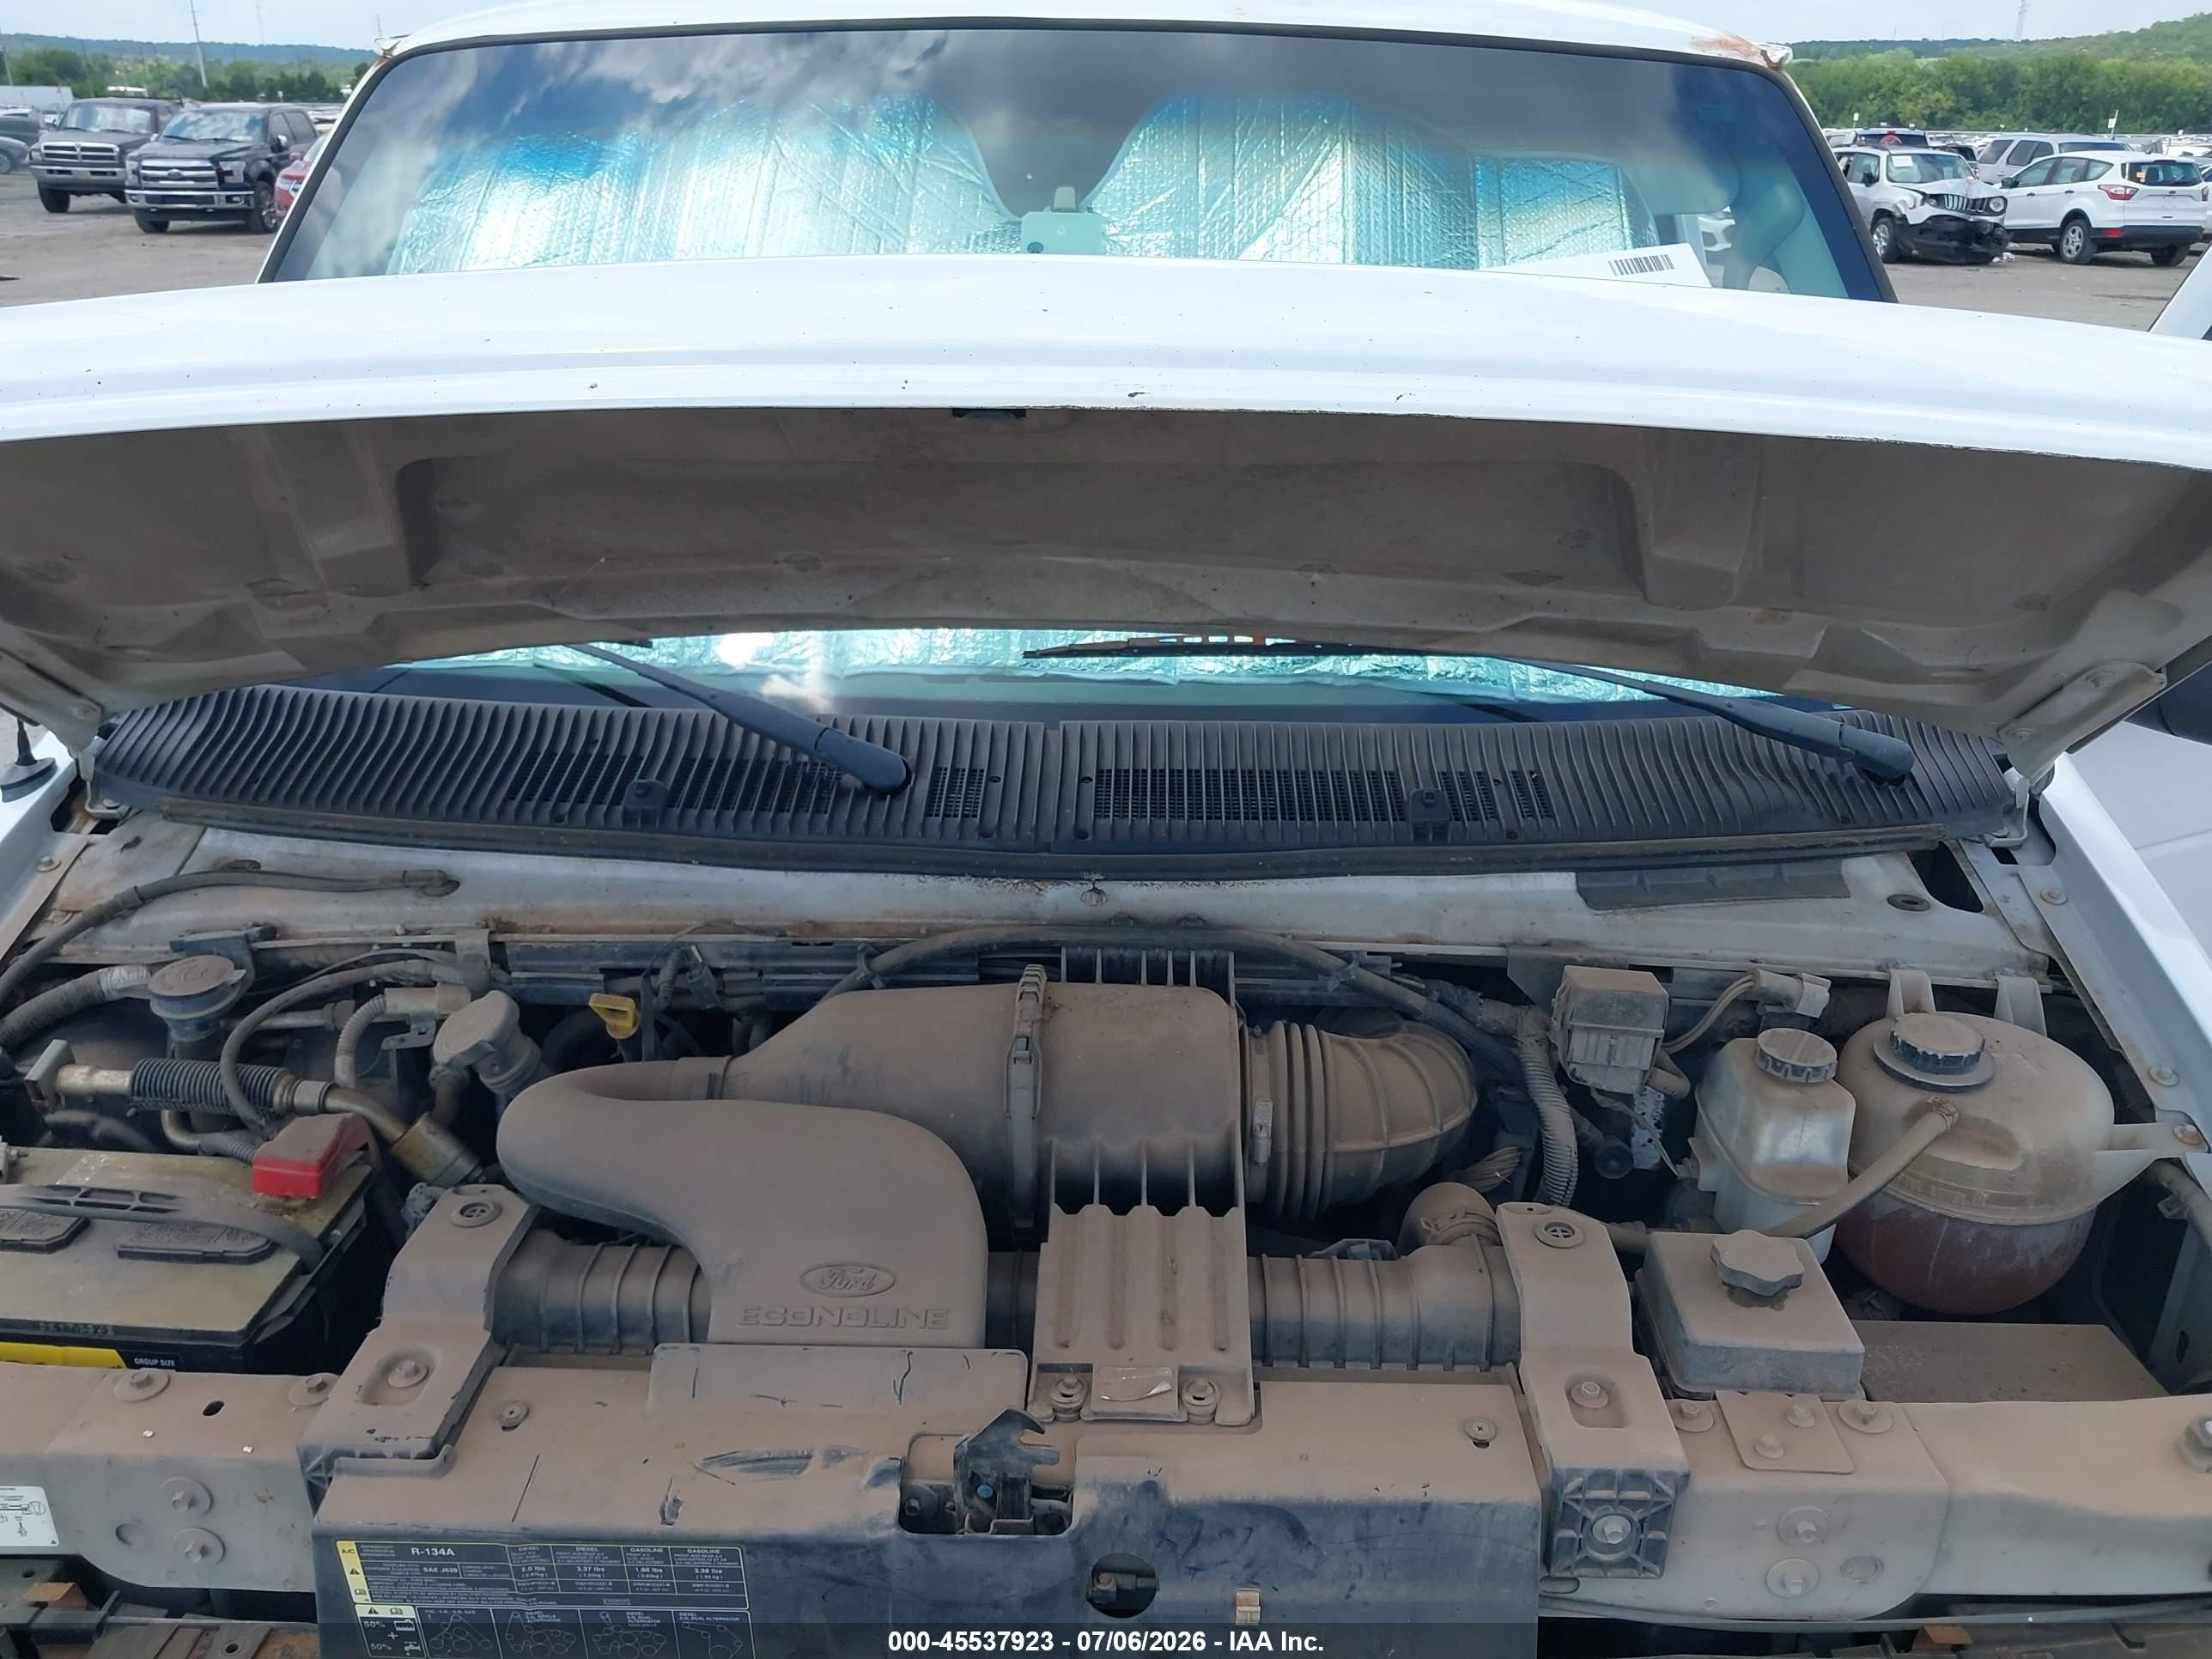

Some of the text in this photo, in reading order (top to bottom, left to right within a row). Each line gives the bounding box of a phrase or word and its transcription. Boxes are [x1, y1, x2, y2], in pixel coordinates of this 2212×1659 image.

[818, 1267, 879, 1291] Ford
[738, 1305, 951, 1329] ECONOLINE
[410, 1547, 455, 1556] R-134A
